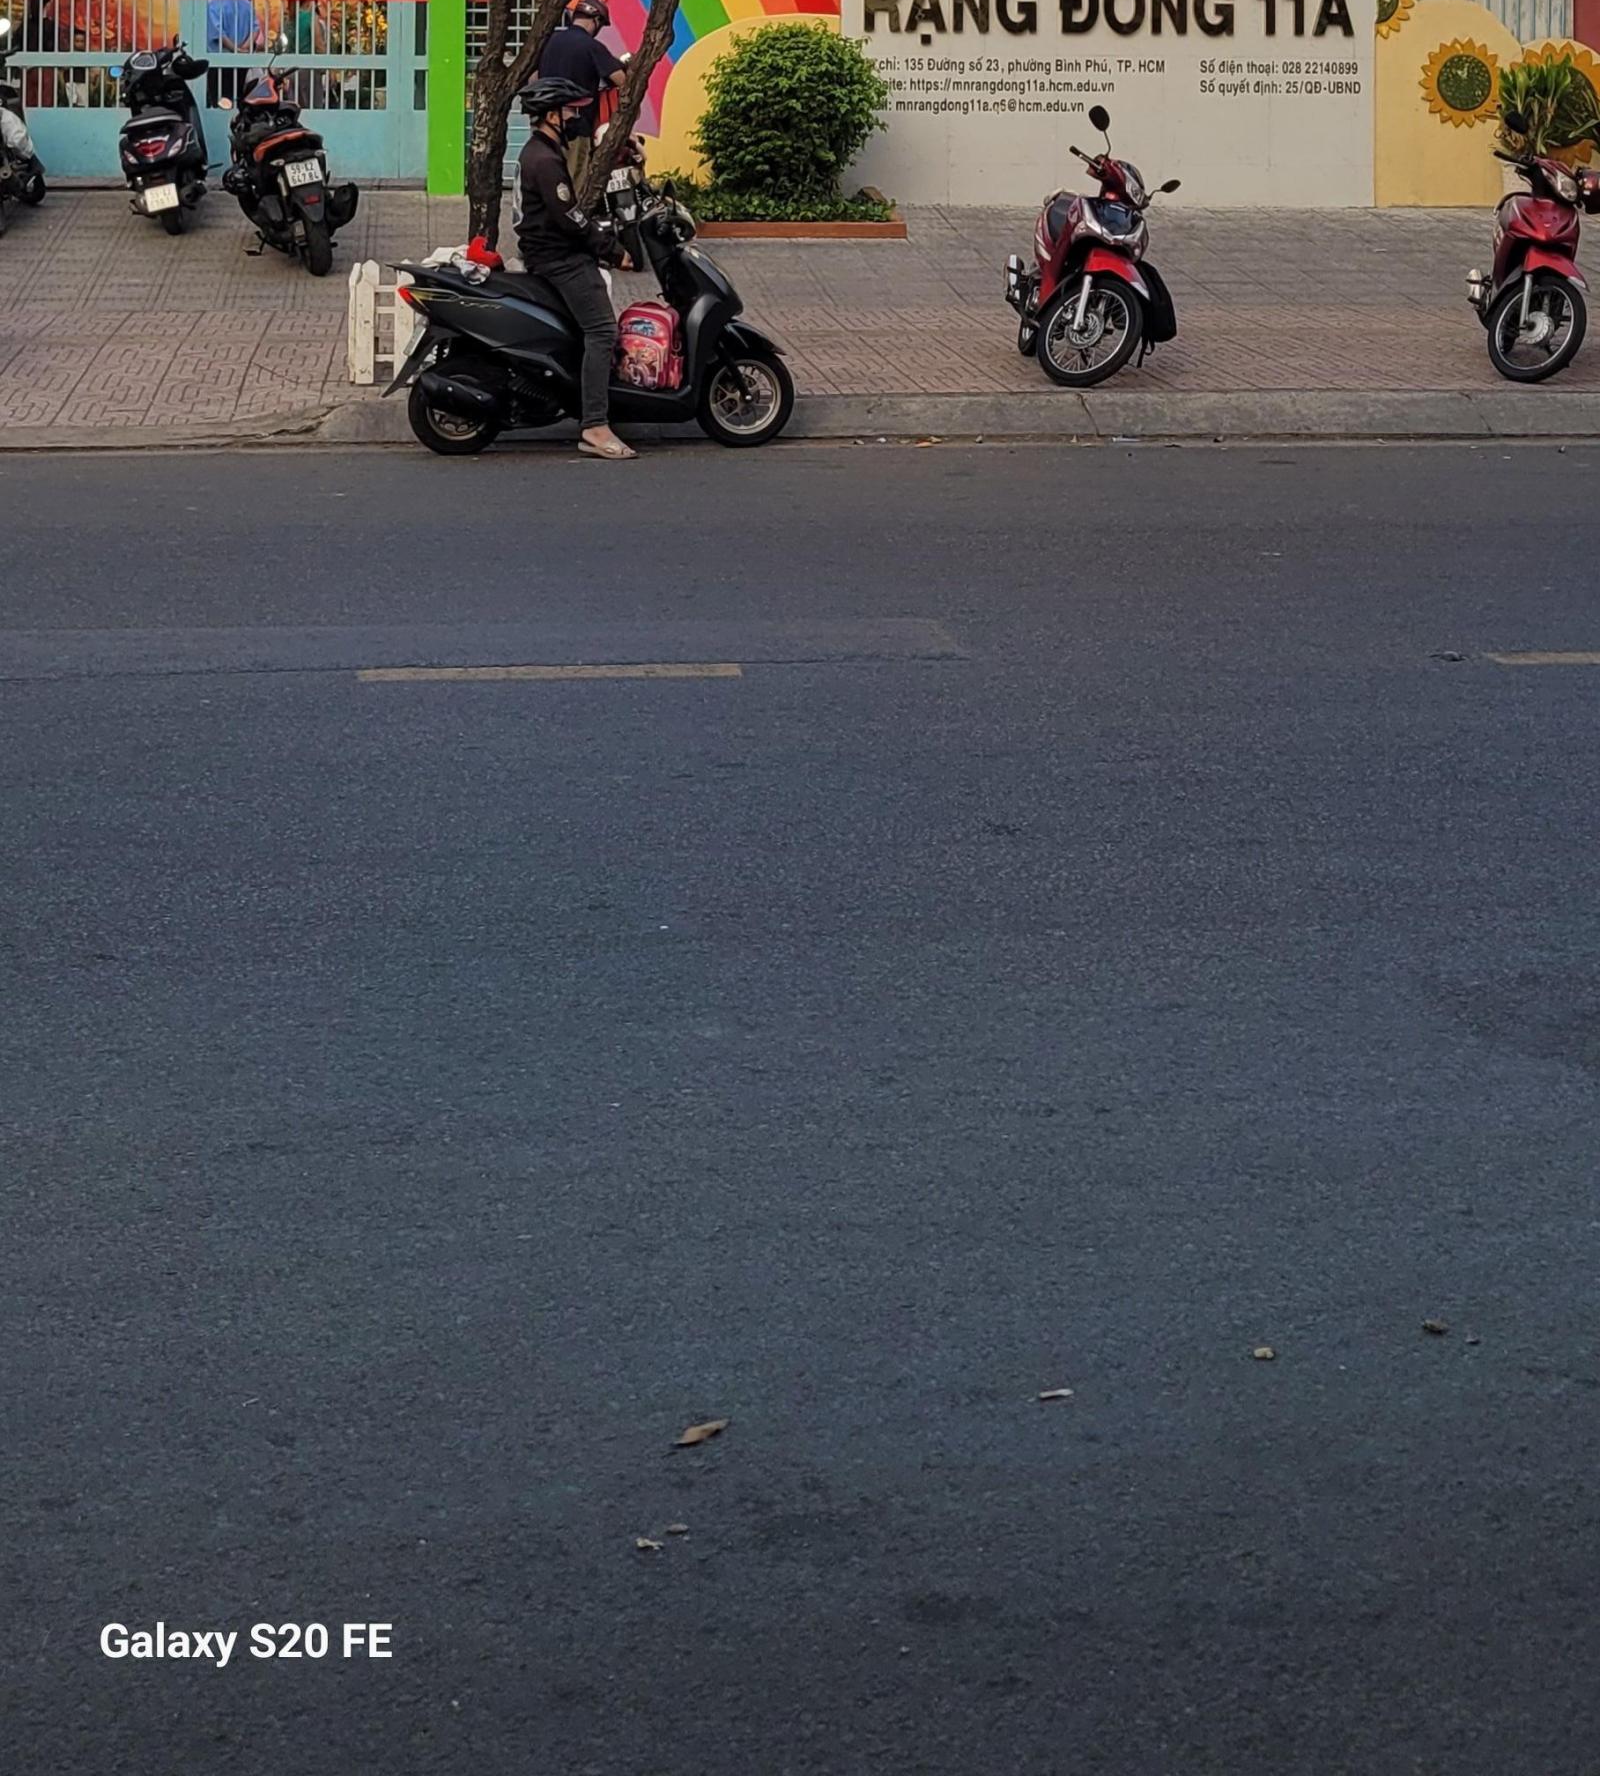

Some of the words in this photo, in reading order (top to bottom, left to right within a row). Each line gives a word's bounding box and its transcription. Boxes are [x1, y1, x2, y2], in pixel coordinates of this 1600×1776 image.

[878, 56, 900, 71] chỉ:
[904, 59, 924, 72] 135
[927, 58, 965, 75] Đường
[968, 56, 984, 72] số
[986, 59, 1005, 74] 23,
[1007, 58, 1052, 76] phường
[1055, 58, 1082, 73] Bình
[1085, 58, 1112, 75] Phú,
[1116, 60, 1136, 73] TP.
[1138, 60, 1165, 74] HCM
[1200, 58, 1216, 74] Số
[1218, 60, 1243, 76] điện
[1247, 60, 1279, 77] thoại:
[1282, 61, 1302, 74] 028
[1305, 61, 1359, 75] 22140899
[910, 78, 1115, 95] https://mnrangdong11a.hcm.edu.vn
[1200, 78, 1216, 94] Số
[1218, 78, 1250, 96] quyết
[1253, 80, 1282, 96] định:
[1285, 81, 1361, 95] 25/QĐ-UBND
